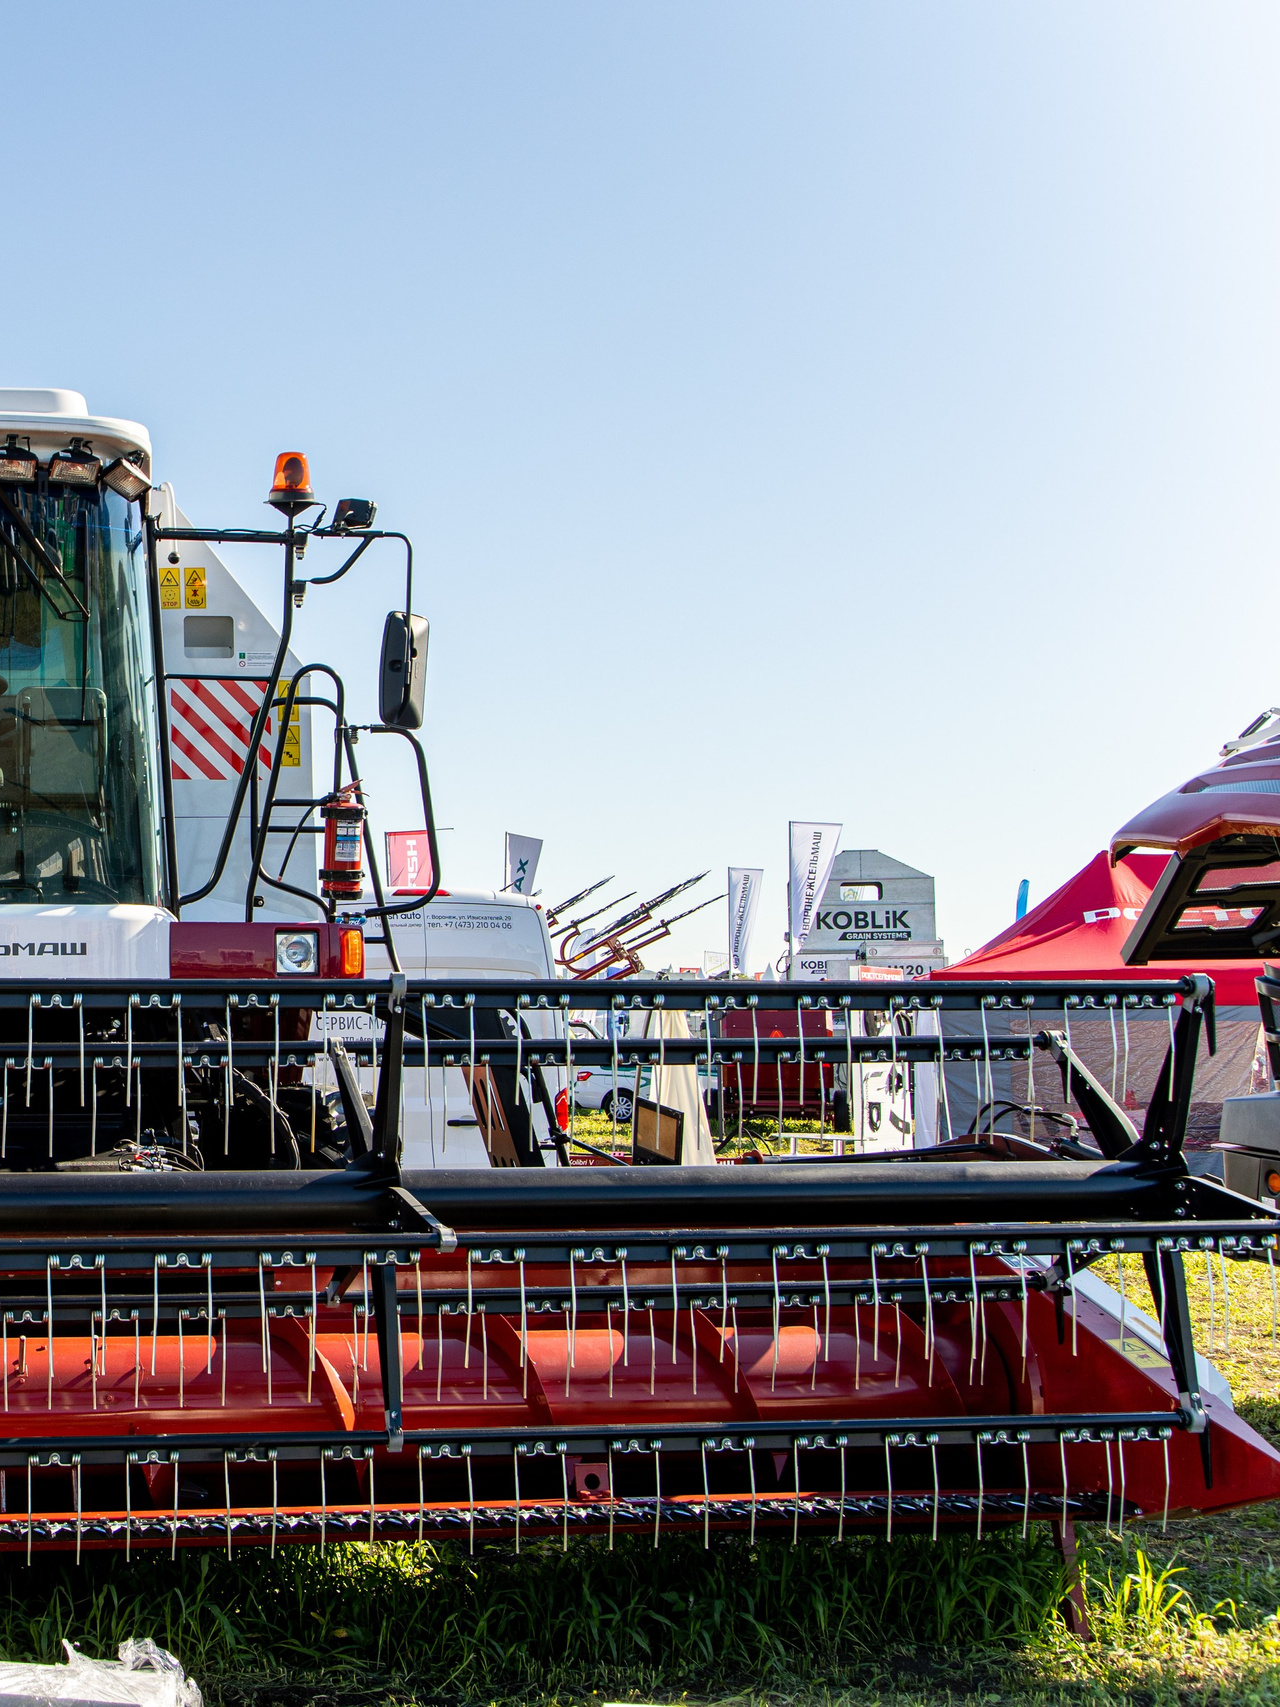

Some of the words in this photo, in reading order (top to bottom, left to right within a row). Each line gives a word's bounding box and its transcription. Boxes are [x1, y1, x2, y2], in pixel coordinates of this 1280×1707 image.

[802, 831, 822, 931] ВОРОНЕЖСЕЛЬМАШ
[400, 911, 422, 920] auto
[734, 874, 750, 953] ВОРОНЕЖСЕЛЬМАШ
[454, 921, 475, 929] (473)
[501, 922, 512, 930] 06
[846, 932, 872, 940] GRAIN
[872, 932, 908, 940] SYSTEMS
